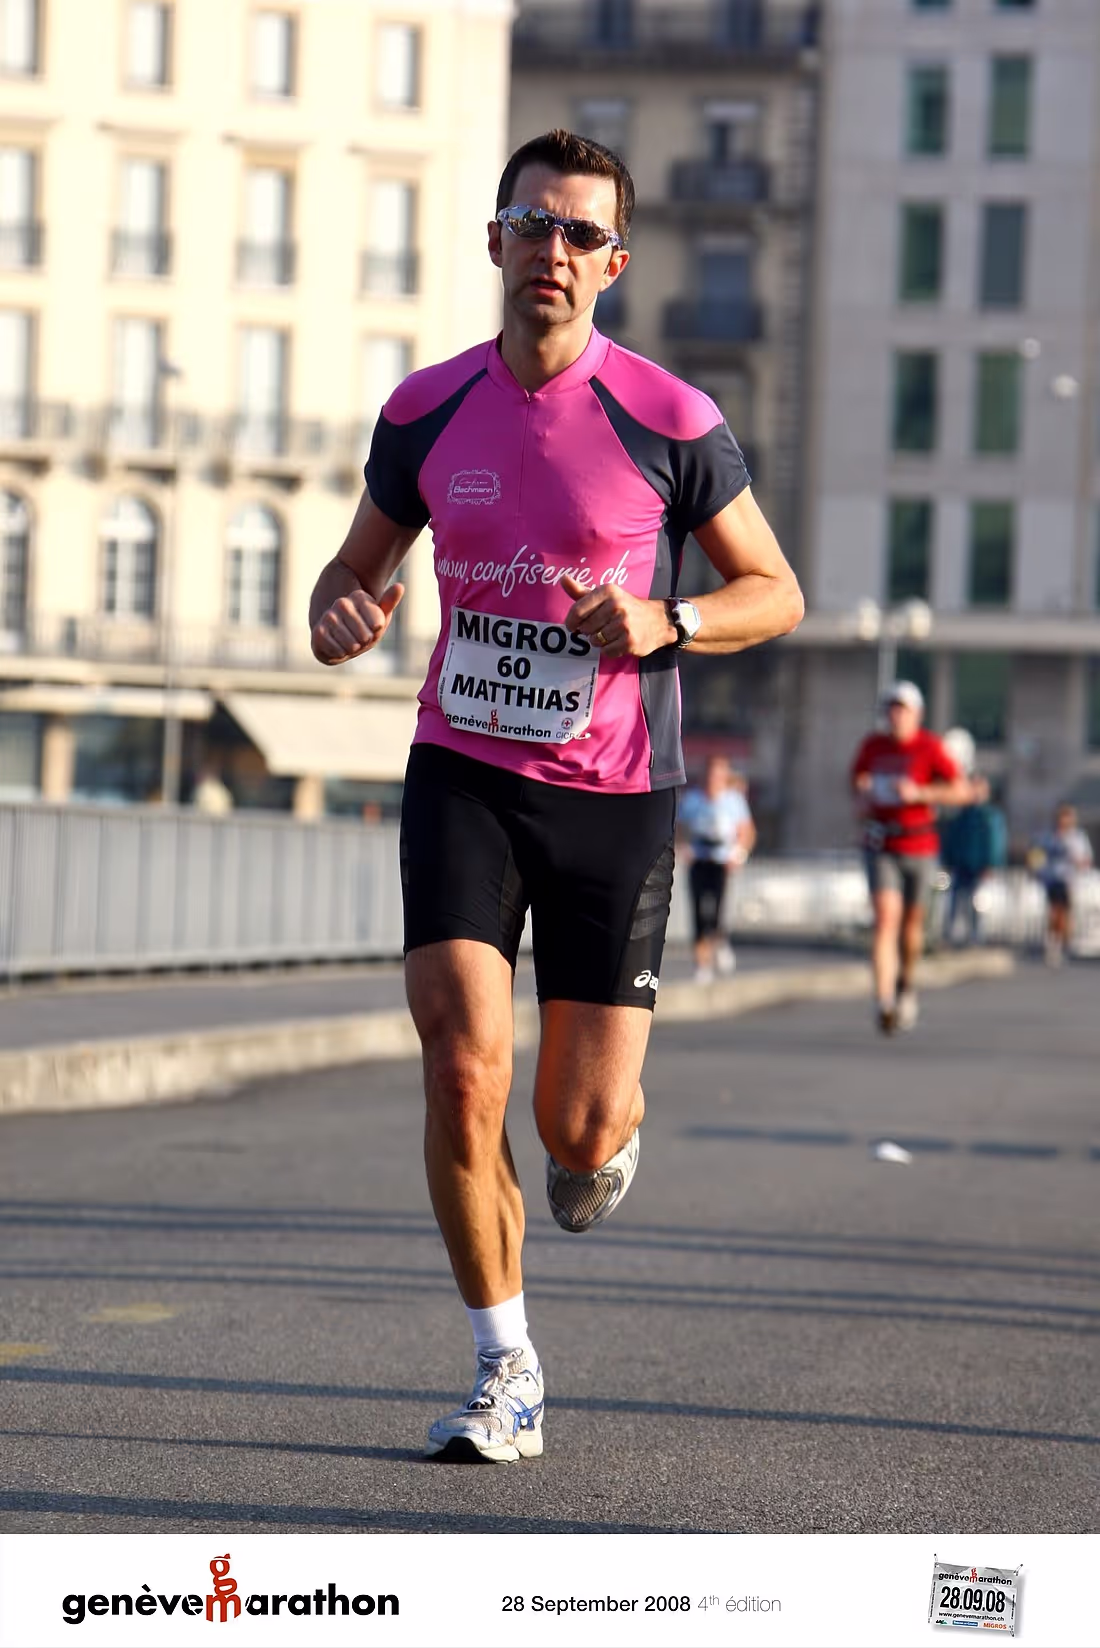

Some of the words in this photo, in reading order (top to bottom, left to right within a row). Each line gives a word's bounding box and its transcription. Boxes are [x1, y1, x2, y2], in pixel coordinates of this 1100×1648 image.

[457, 611, 591, 656] MIGROS
[497, 655, 531, 680] 60
[450, 673, 581, 712] MATTHIAS
